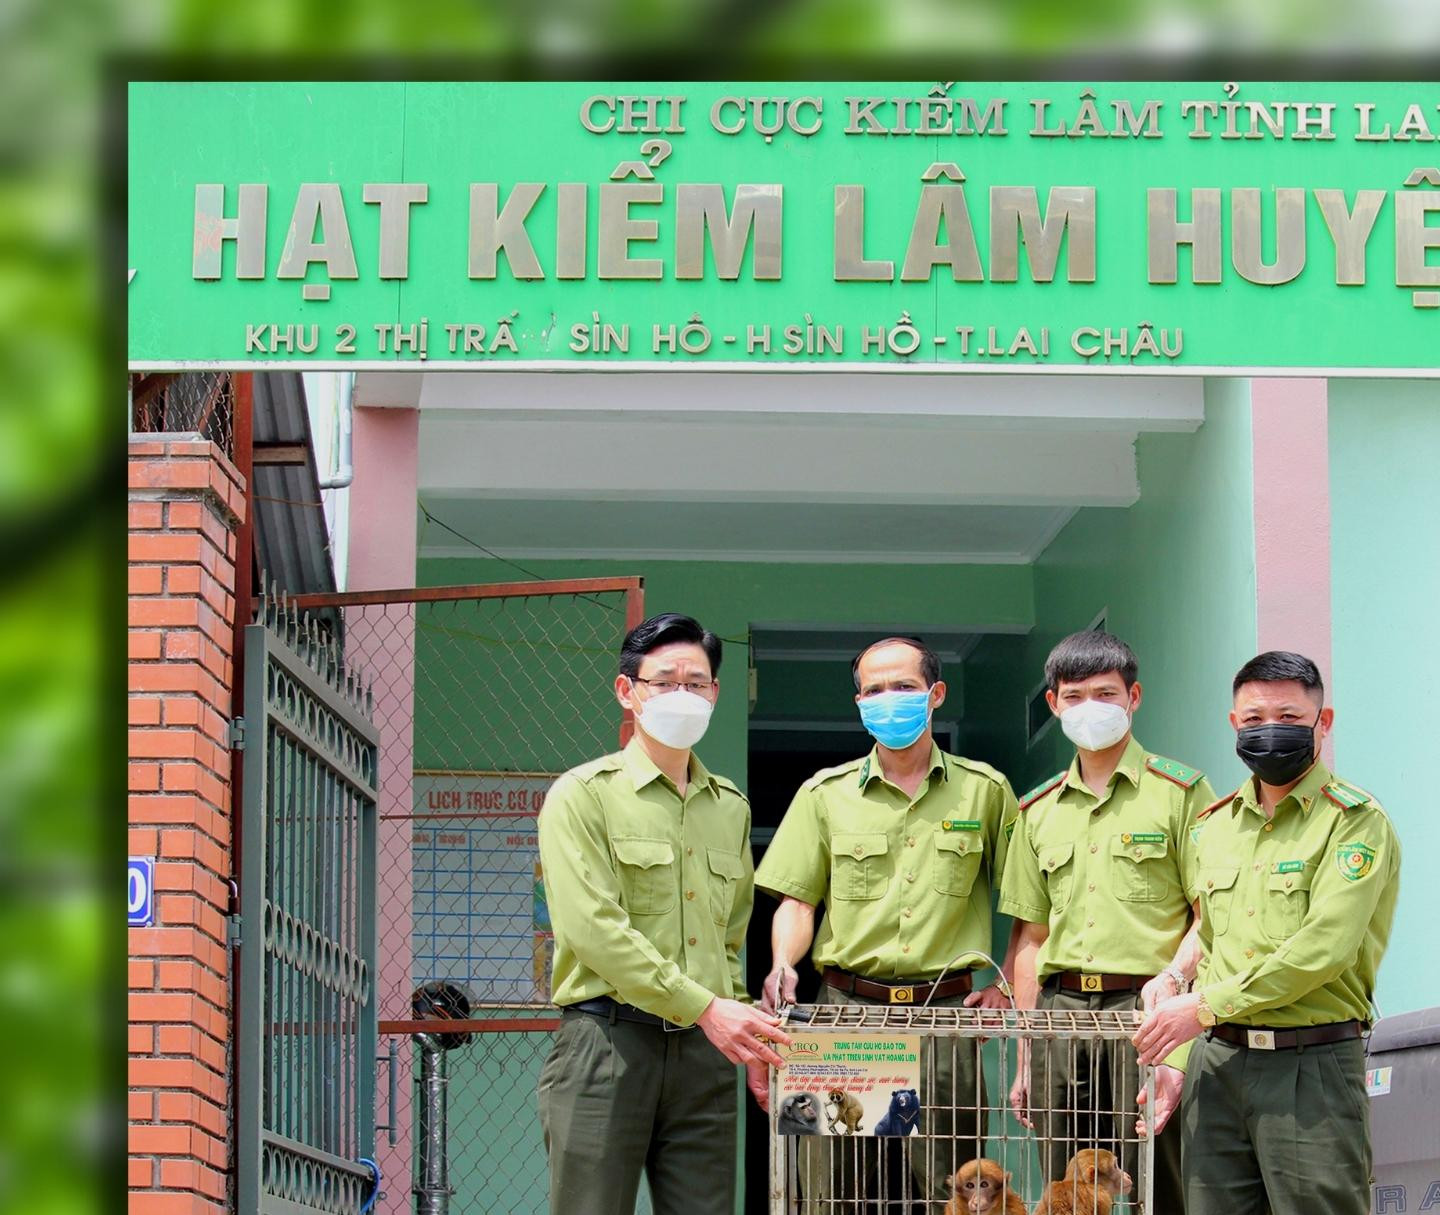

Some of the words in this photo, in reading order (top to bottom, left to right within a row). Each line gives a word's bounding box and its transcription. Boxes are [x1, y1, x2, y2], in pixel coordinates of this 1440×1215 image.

[579, 95, 687, 135] CHI
[709, 96, 824, 143] CỤC
[1029, 88, 1163, 138] LÂM
[1181, 82, 1337, 140] TỈNH
[192, 183, 429, 301] HẠT
[468, 139, 785, 282] KIỂM
[834, 162, 1097, 284] LÂM
[245, 324, 319, 353] KHU
[335, 324, 357, 354] 2
[374, 317, 429, 360] THỊ
[569, 311, 630, 354] SÌN
[1070, 320, 1184, 359] CHÂU
